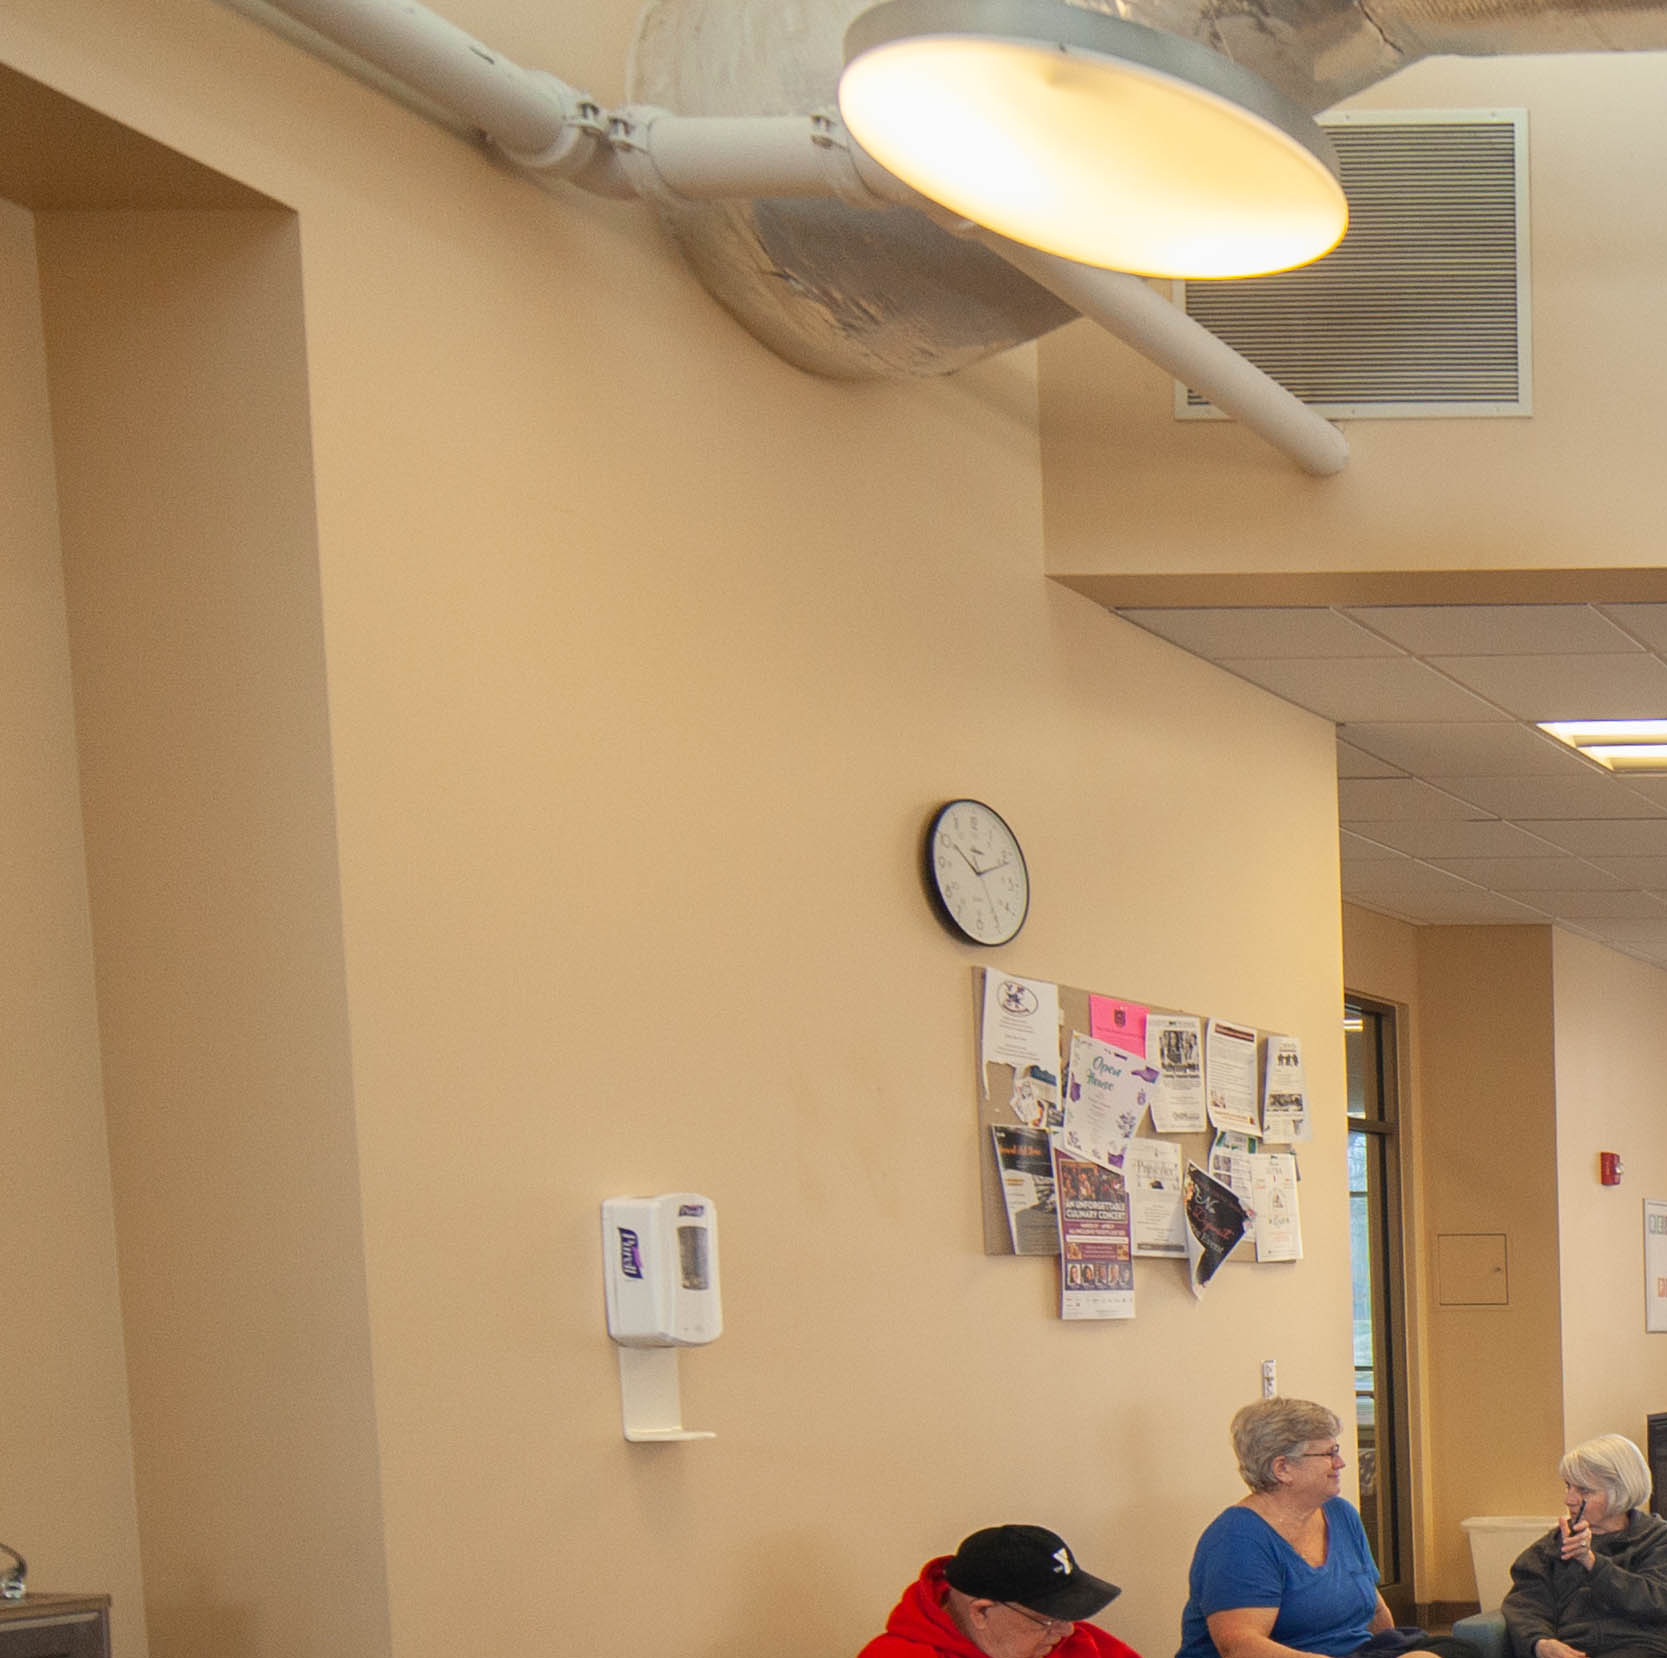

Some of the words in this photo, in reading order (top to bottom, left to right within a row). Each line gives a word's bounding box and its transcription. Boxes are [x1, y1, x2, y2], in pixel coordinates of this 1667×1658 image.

[1092, 1056, 1122, 1077] Open
[1087, 1069, 1114, 1091] House
[1066, 1209, 1097, 1219] CULINARY
[1098, 1210, 1126, 1220] CONCERT
[1077, 1201, 1126, 1211] UNFORGETTABLE
[1053, 1548, 1072, 1575] Y
